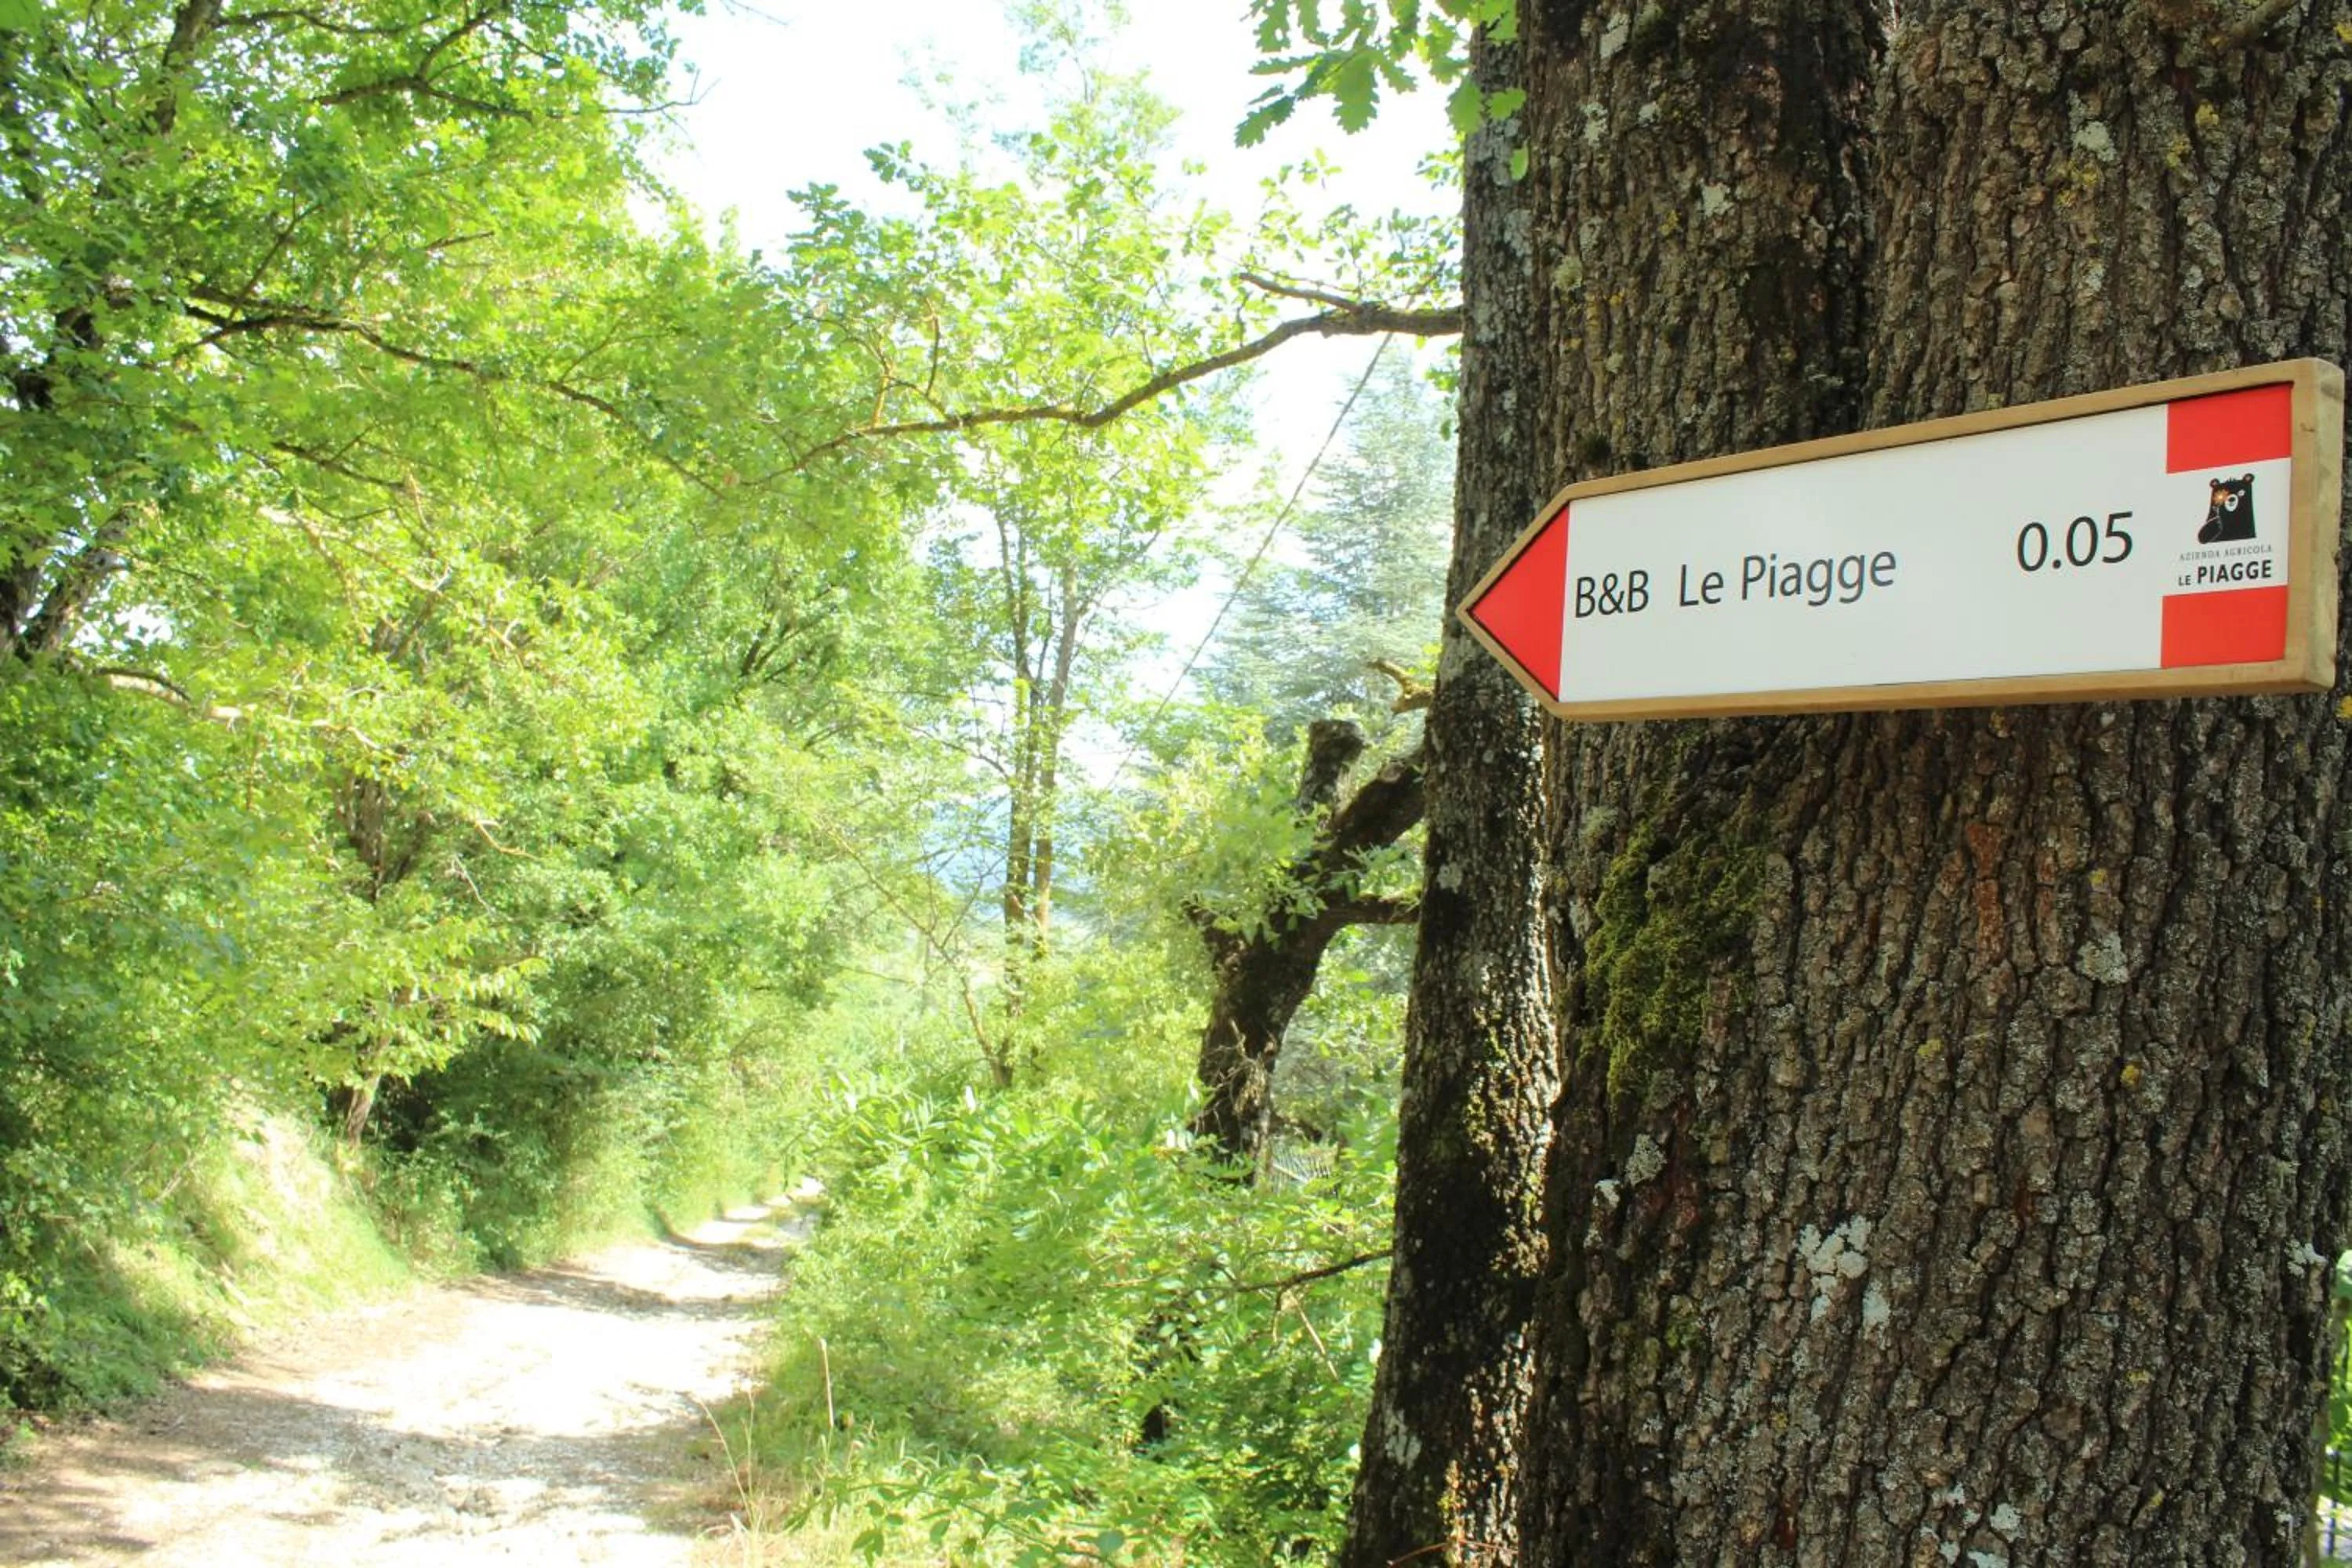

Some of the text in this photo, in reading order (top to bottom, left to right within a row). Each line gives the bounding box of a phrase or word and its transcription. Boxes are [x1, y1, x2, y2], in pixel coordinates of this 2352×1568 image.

[2017, 511, 2133, 572] 0.05
[2180, 544, 2272, 561] AZIENDA AGRICOLA
[1575, 551, 1896, 619] B&B Le Piagge
[2178, 560, 2272, 586] LE PIAGGE
